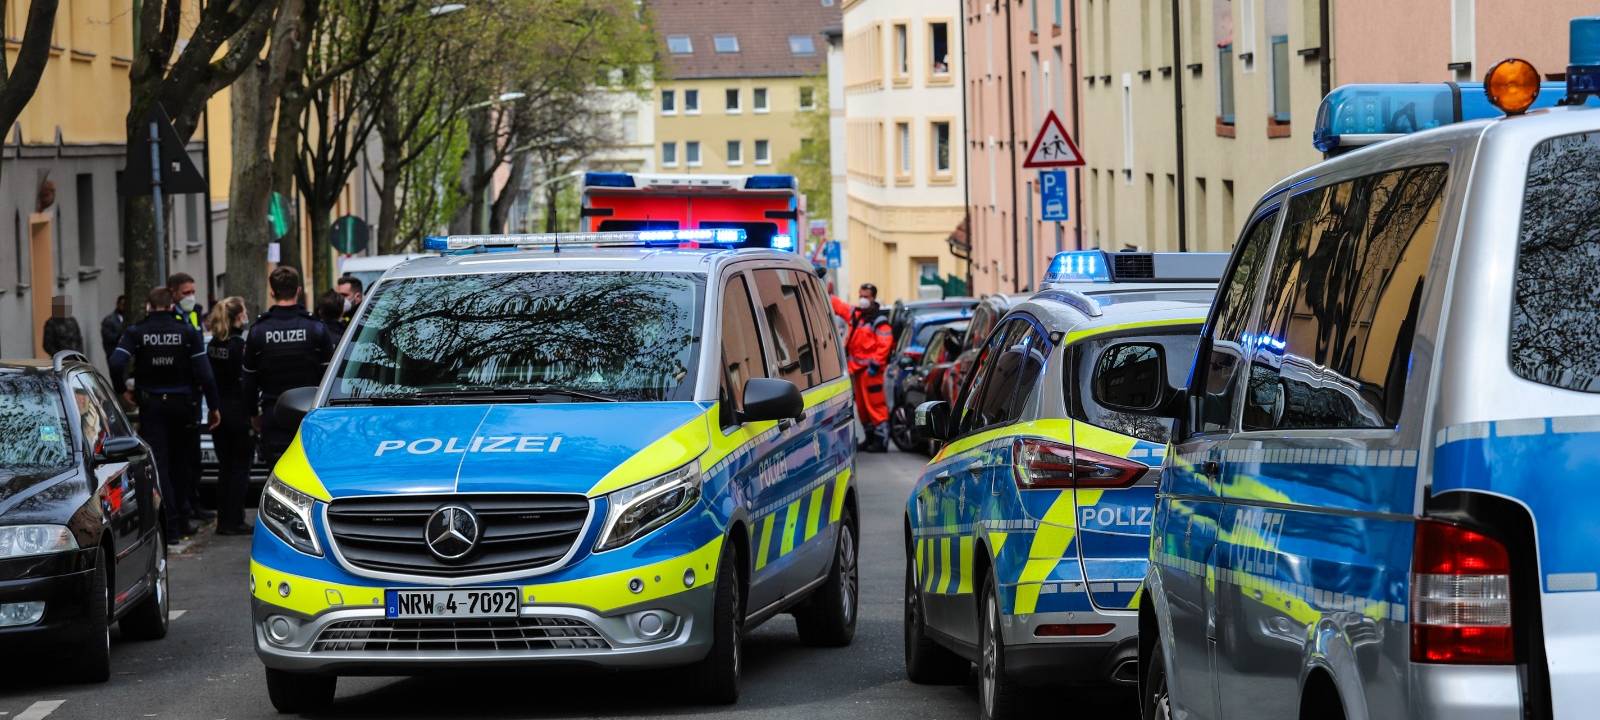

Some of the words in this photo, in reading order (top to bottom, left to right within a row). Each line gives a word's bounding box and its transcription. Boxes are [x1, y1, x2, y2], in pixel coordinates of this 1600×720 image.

[1043, 174, 1056, 194] P
[143, 334, 181, 345] POLIZEI
[266, 329, 306, 343] POLIZEI
[152, 357, 173, 366] NRW
[374, 436, 562, 457] POLIZEI
[758, 450, 788, 490] POLIZEI
[1229, 508, 1286, 576] POLIZEI
[398, 593, 434, 614] NRW
[446, 592, 516, 613] 4-7092
